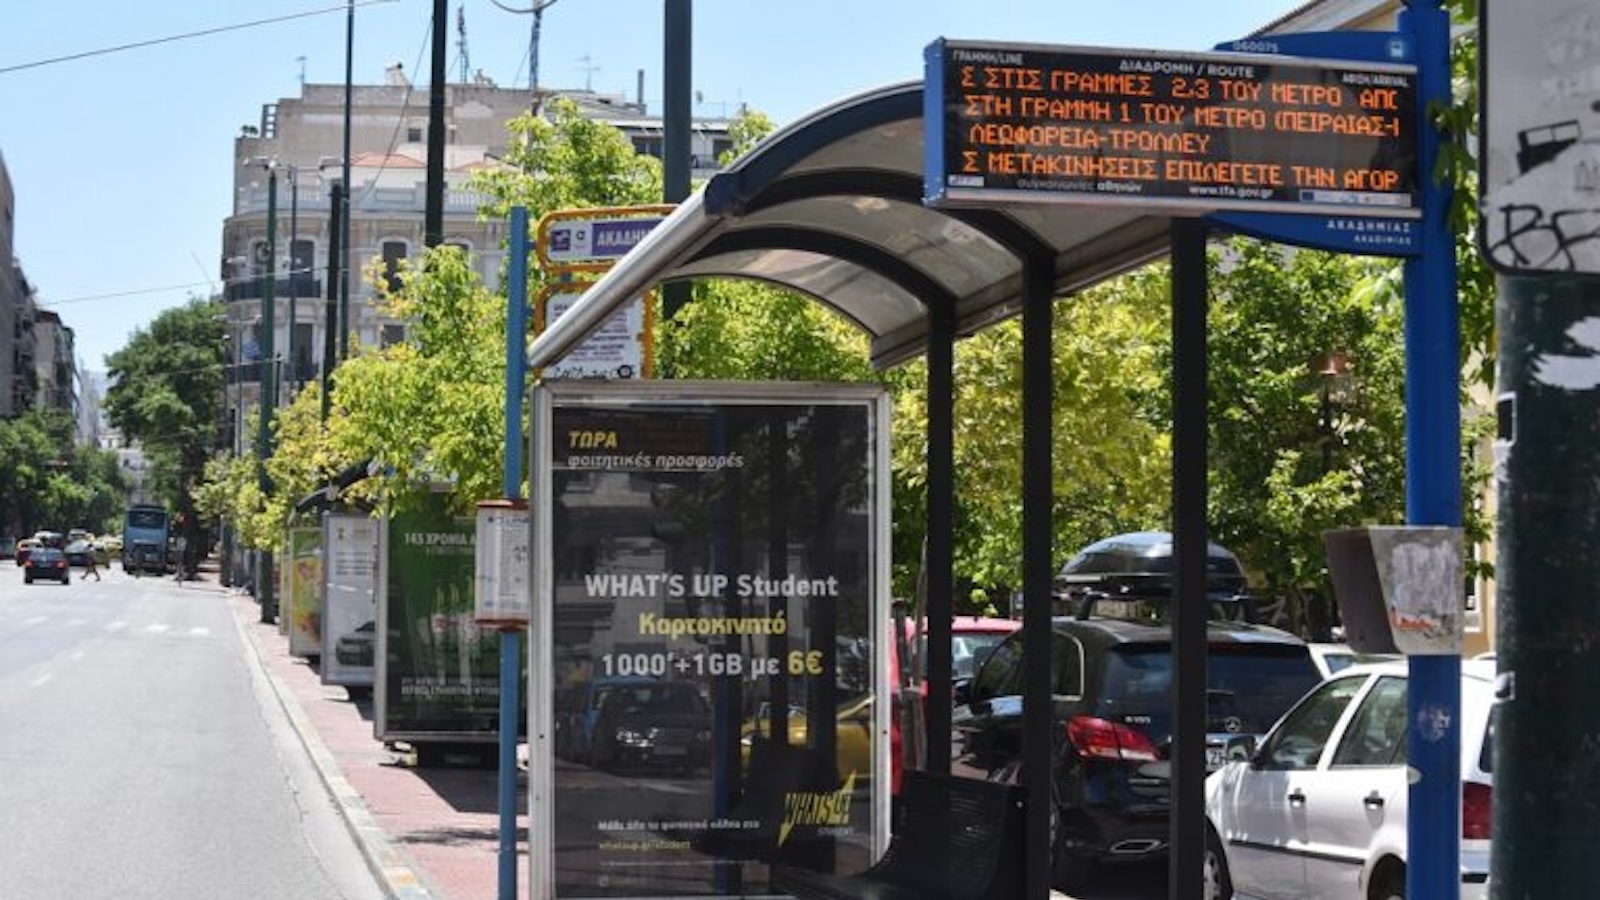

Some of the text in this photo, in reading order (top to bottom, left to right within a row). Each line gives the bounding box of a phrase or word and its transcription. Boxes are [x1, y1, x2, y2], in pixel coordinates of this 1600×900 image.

[1119, 59, 1196, 76] ΔΙΑΔΡΟΜΗ
[1207, 64, 1254, 79] ROUTE
[984, 67, 1042, 91] ΣΤΙΣ
[1051, 71, 1153, 97] ΓΡΑΜΜΕΣ
[1219, 80, 1262, 102] ΤΟΥ
[1272, 83, 1342, 107] ΜΕΤΡΟ
[964, 95, 1012, 117] ΣΤΗ
[1021, 97, 1111, 121] ΓΡΑΜΜΗ
[1141, 104, 1185, 125] ΤΟΥ
[1194, 107, 1267, 130] ΜΕΤΡΟ
[1274, 111, 1399, 137] (ΠΕΙΡΑΙΑΣ-
[969, 124, 1210, 153] ΛΕΩΦΟΡΕΙΑ-ΤΡΟΛΛΕΥ
[988, 152, 1157, 180] ΜΕΤΑΚΙΝΗΣΕΙΣ
[1166, 160, 1283, 185] ΕΠΙΛΕΓΕΤΕ
[1343, 169, 1399, 190] ΑΓΟΡ
[1326, 219, 1411, 233] ΑΚΑΔΗΜΙΑΣ
[568, 431, 619, 449] ΤΩΡΑ
[568, 452, 744, 471] φοιτητικές προσφορές
[693, 574, 729, 598] UP
[736, 574, 838, 598] Student
[638, 611, 787, 640] Καρτοκινητό
[750, 656, 780, 680] με
[787, 650, 824, 676] 6€
